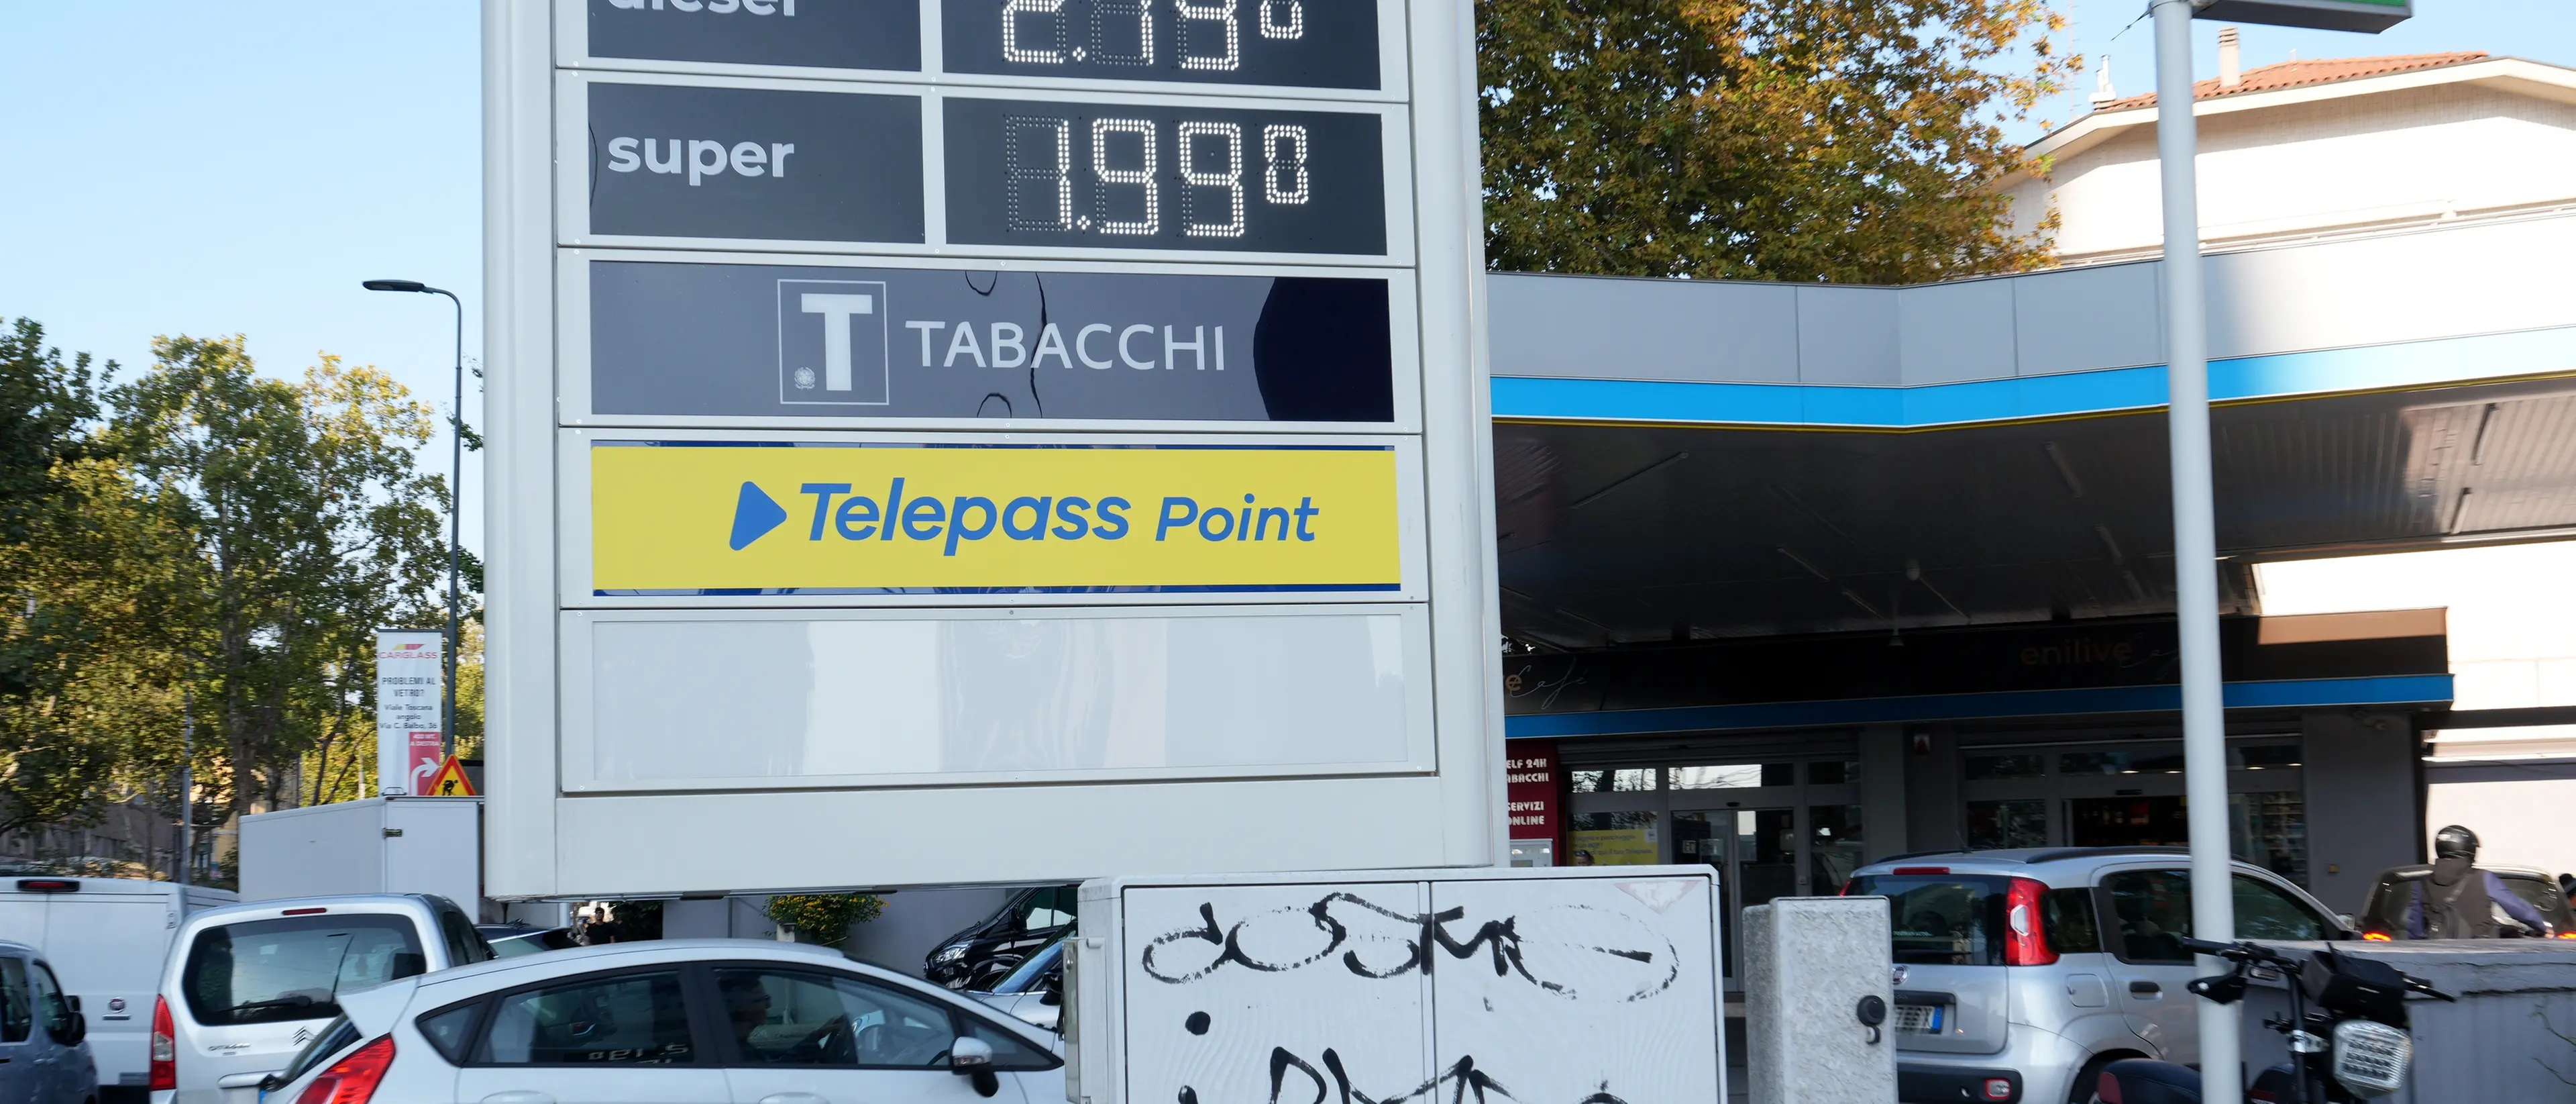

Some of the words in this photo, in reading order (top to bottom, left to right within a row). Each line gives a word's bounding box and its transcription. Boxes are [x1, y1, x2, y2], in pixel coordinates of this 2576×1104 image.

[607, 134, 794, 187] super
[905, 320, 1226, 371] TABACCHI
[800, 477, 1132, 556] Telepass
[1156, 493, 1320, 543] Point
[2019, 637, 2133, 666] enilive
[382, 677, 425, 685] PROBLEMI
[426, 677, 436, 685] AL
[393, 689, 425, 697] VETRO?
[396, 713, 422, 721] angolo
[1506, 760, 1523, 769] ELF
[1526, 758, 1547, 768] 24H
[1507, 772, 1550, 783] ABACCHI
